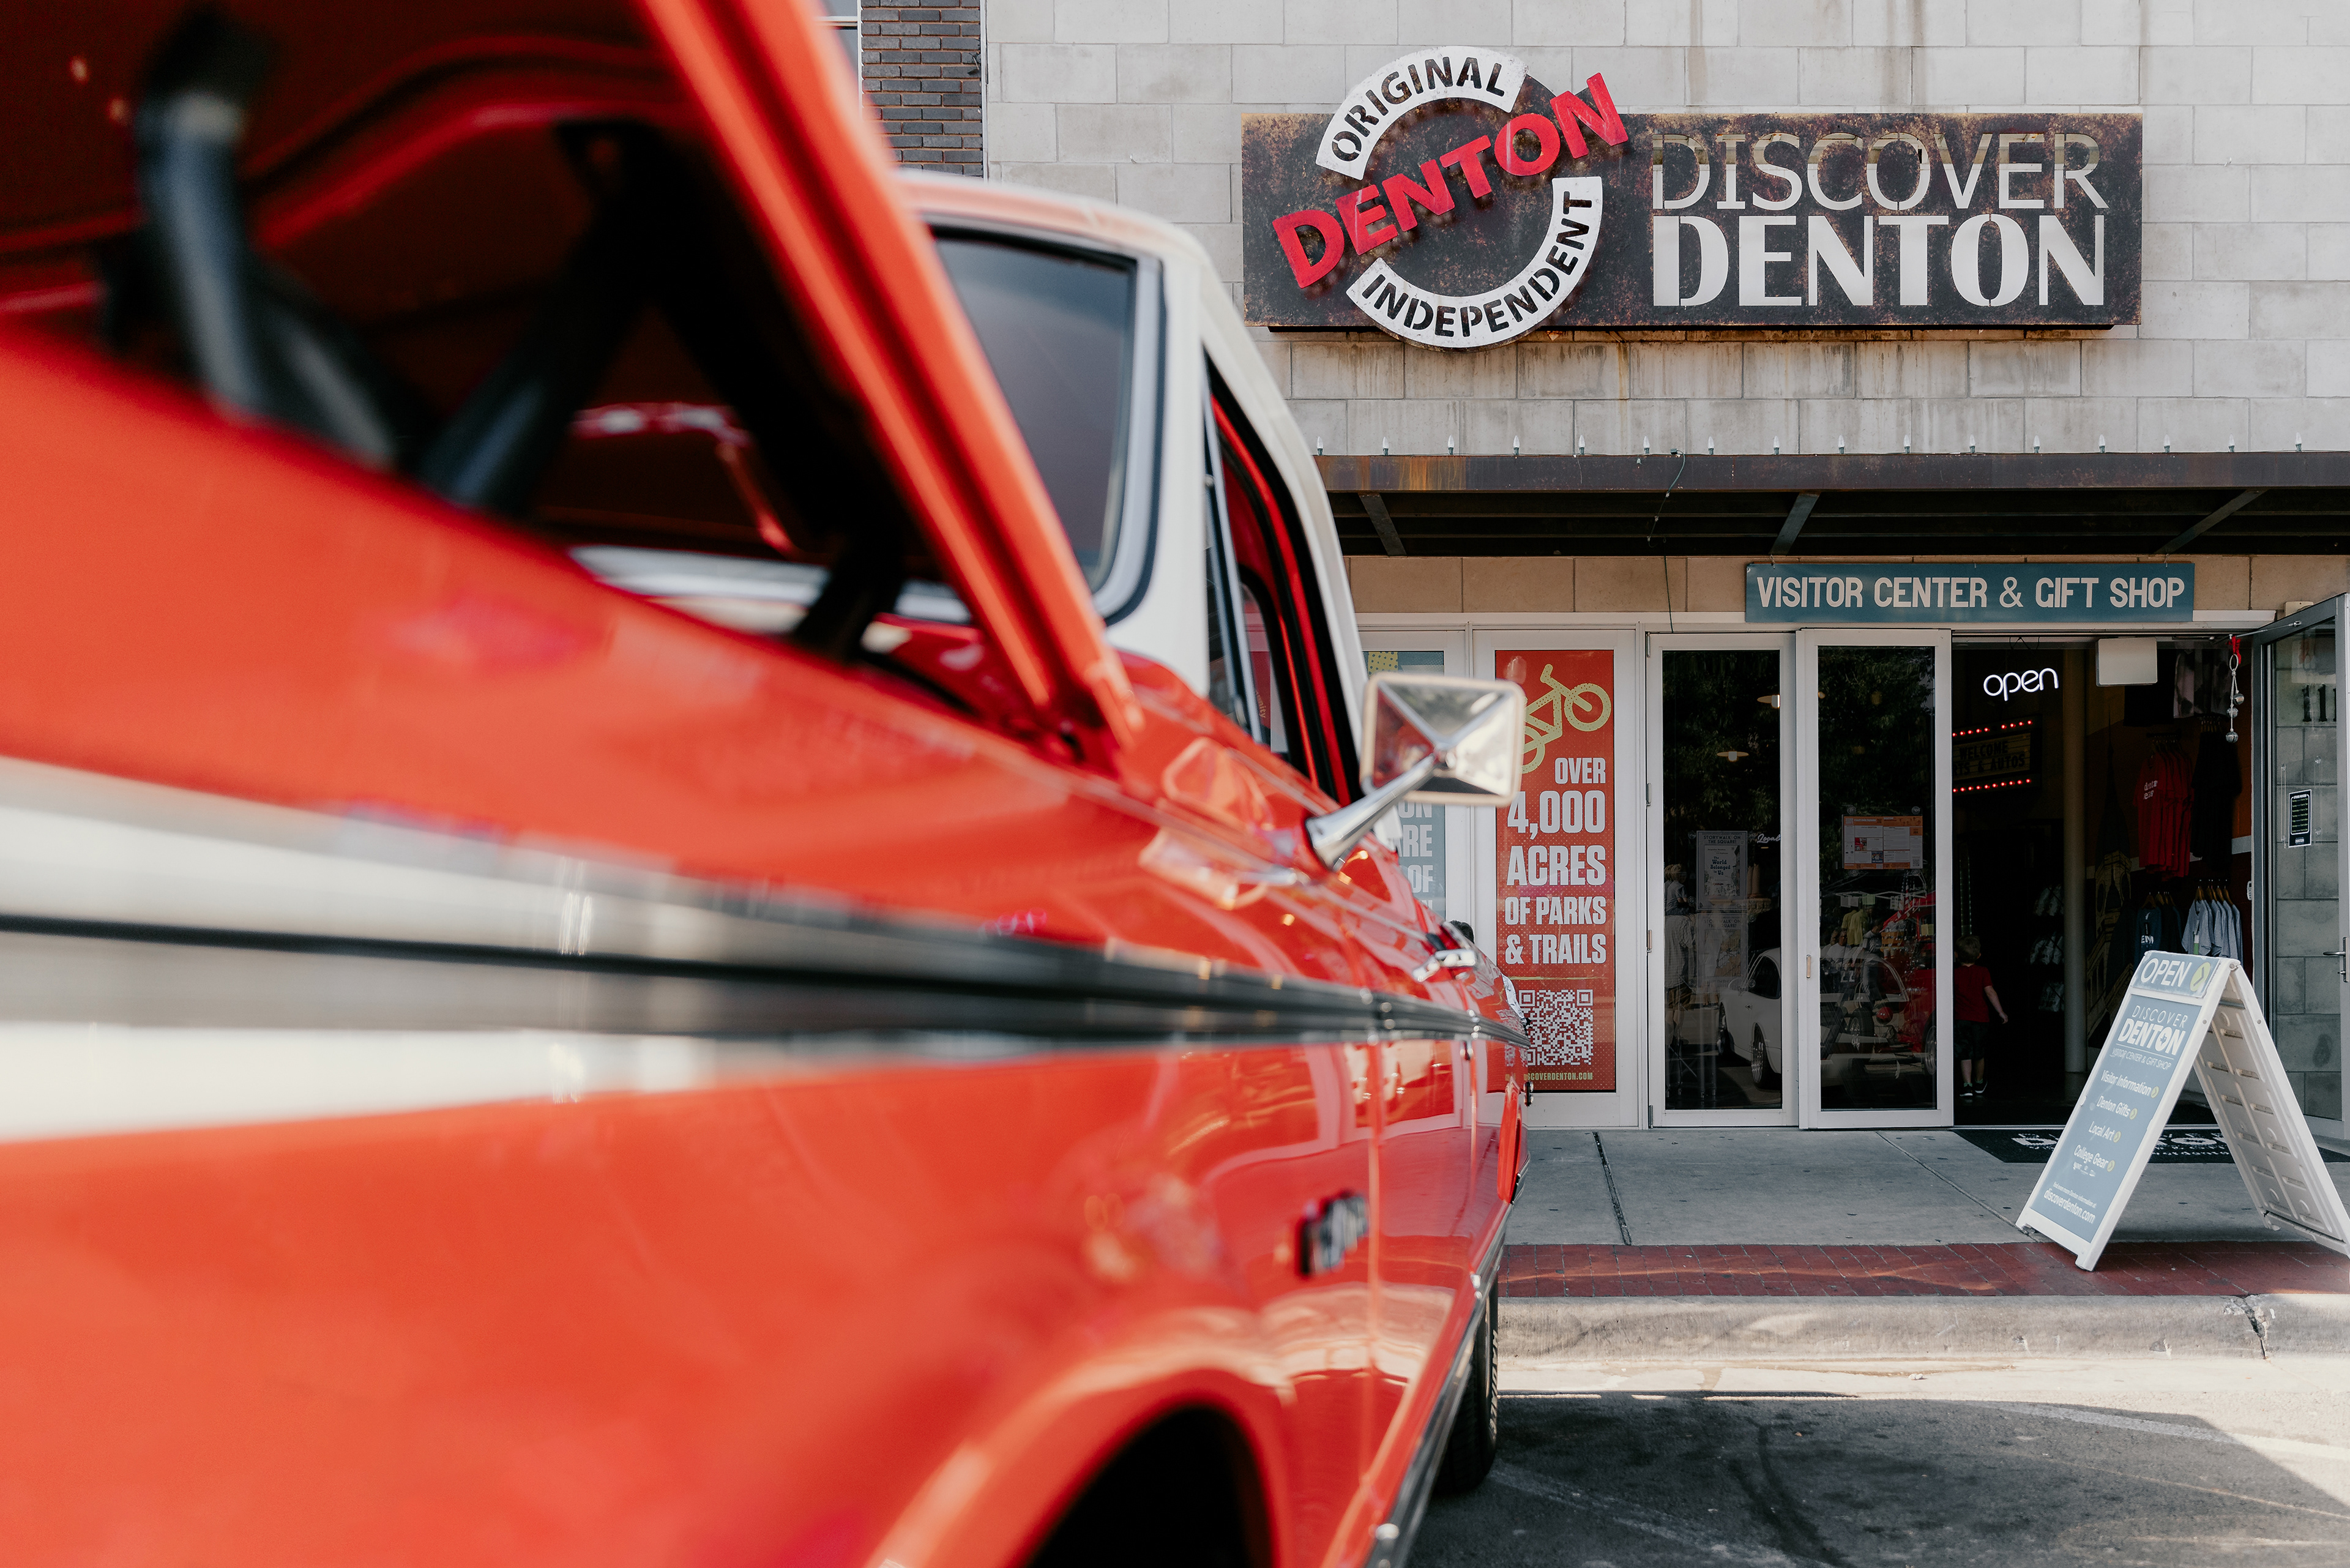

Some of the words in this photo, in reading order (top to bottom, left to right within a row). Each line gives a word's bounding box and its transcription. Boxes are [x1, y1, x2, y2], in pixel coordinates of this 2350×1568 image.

[1331, 56, 1505, 163] ORIGINAL
[1272, 72, 1628, 289] DENTON
[1652, 132, 2109, 211] DISCOVER
[1362, 191, 1593, 338] INDEPENDENT
[1653, 214, 2104, 307] DENTON
[1756, 577, 1863, 608] VISITOR
[1874, 577, 1988, 608] CENTER
[1999, 577, 2024, 608] &
[2035, 577, 2098, 608] GIFT
[2109, 577, 2185, 608] SHOP
[1983, 668, 2059, 701] open
[1953, 761, 1970, 776] RTS
[1990, 753, 2025, 771] AUTOS
[1960, 741, 2008, 760] WELCOME
[1555, 758, 1606, 784] OVER
[1507, 790, 1606, 840] 4,000
[1408, 864, 1433, 893] OF
[1507, 845, 1606, 886] ACRES
[1505, 897, 1532, 925] OF
[1536, 897, 1606, 925] PARKS
[1505, 935, 1524, 964] &
[1529, 933, 1606, 964] TRAILS
[2141, 957, 2191, 988] OPEN
[2132, 1006, 2188, 1029] DISCOVER
[2117, 1018, 2186, 1055] DENTON
[2111, 1047, 2127, 1059] VISITOR
[2125, 1051, 2142, 1062] CENTER
[2146, 1057, 2158, 1066] GIFT
[2156, 1059, 2172, 1070] SHOP
[2102, 1069, 2118, 1085] Visitor
[2117, 1073, 2151, 1097] Information
[2096, 1096, 2115, 1112] Denton
[2113, 1100, 2130, 1119] Gifts
[2088, 1121, 2103, 1136] Local
[2103, 1128, 2114, 1142] Art
[2073, 1144, 2094, 1164] College
[2092, 1152, 2109, 1169] Gear
[2043, 1188, 2095, 1224] discoverdenton.com
